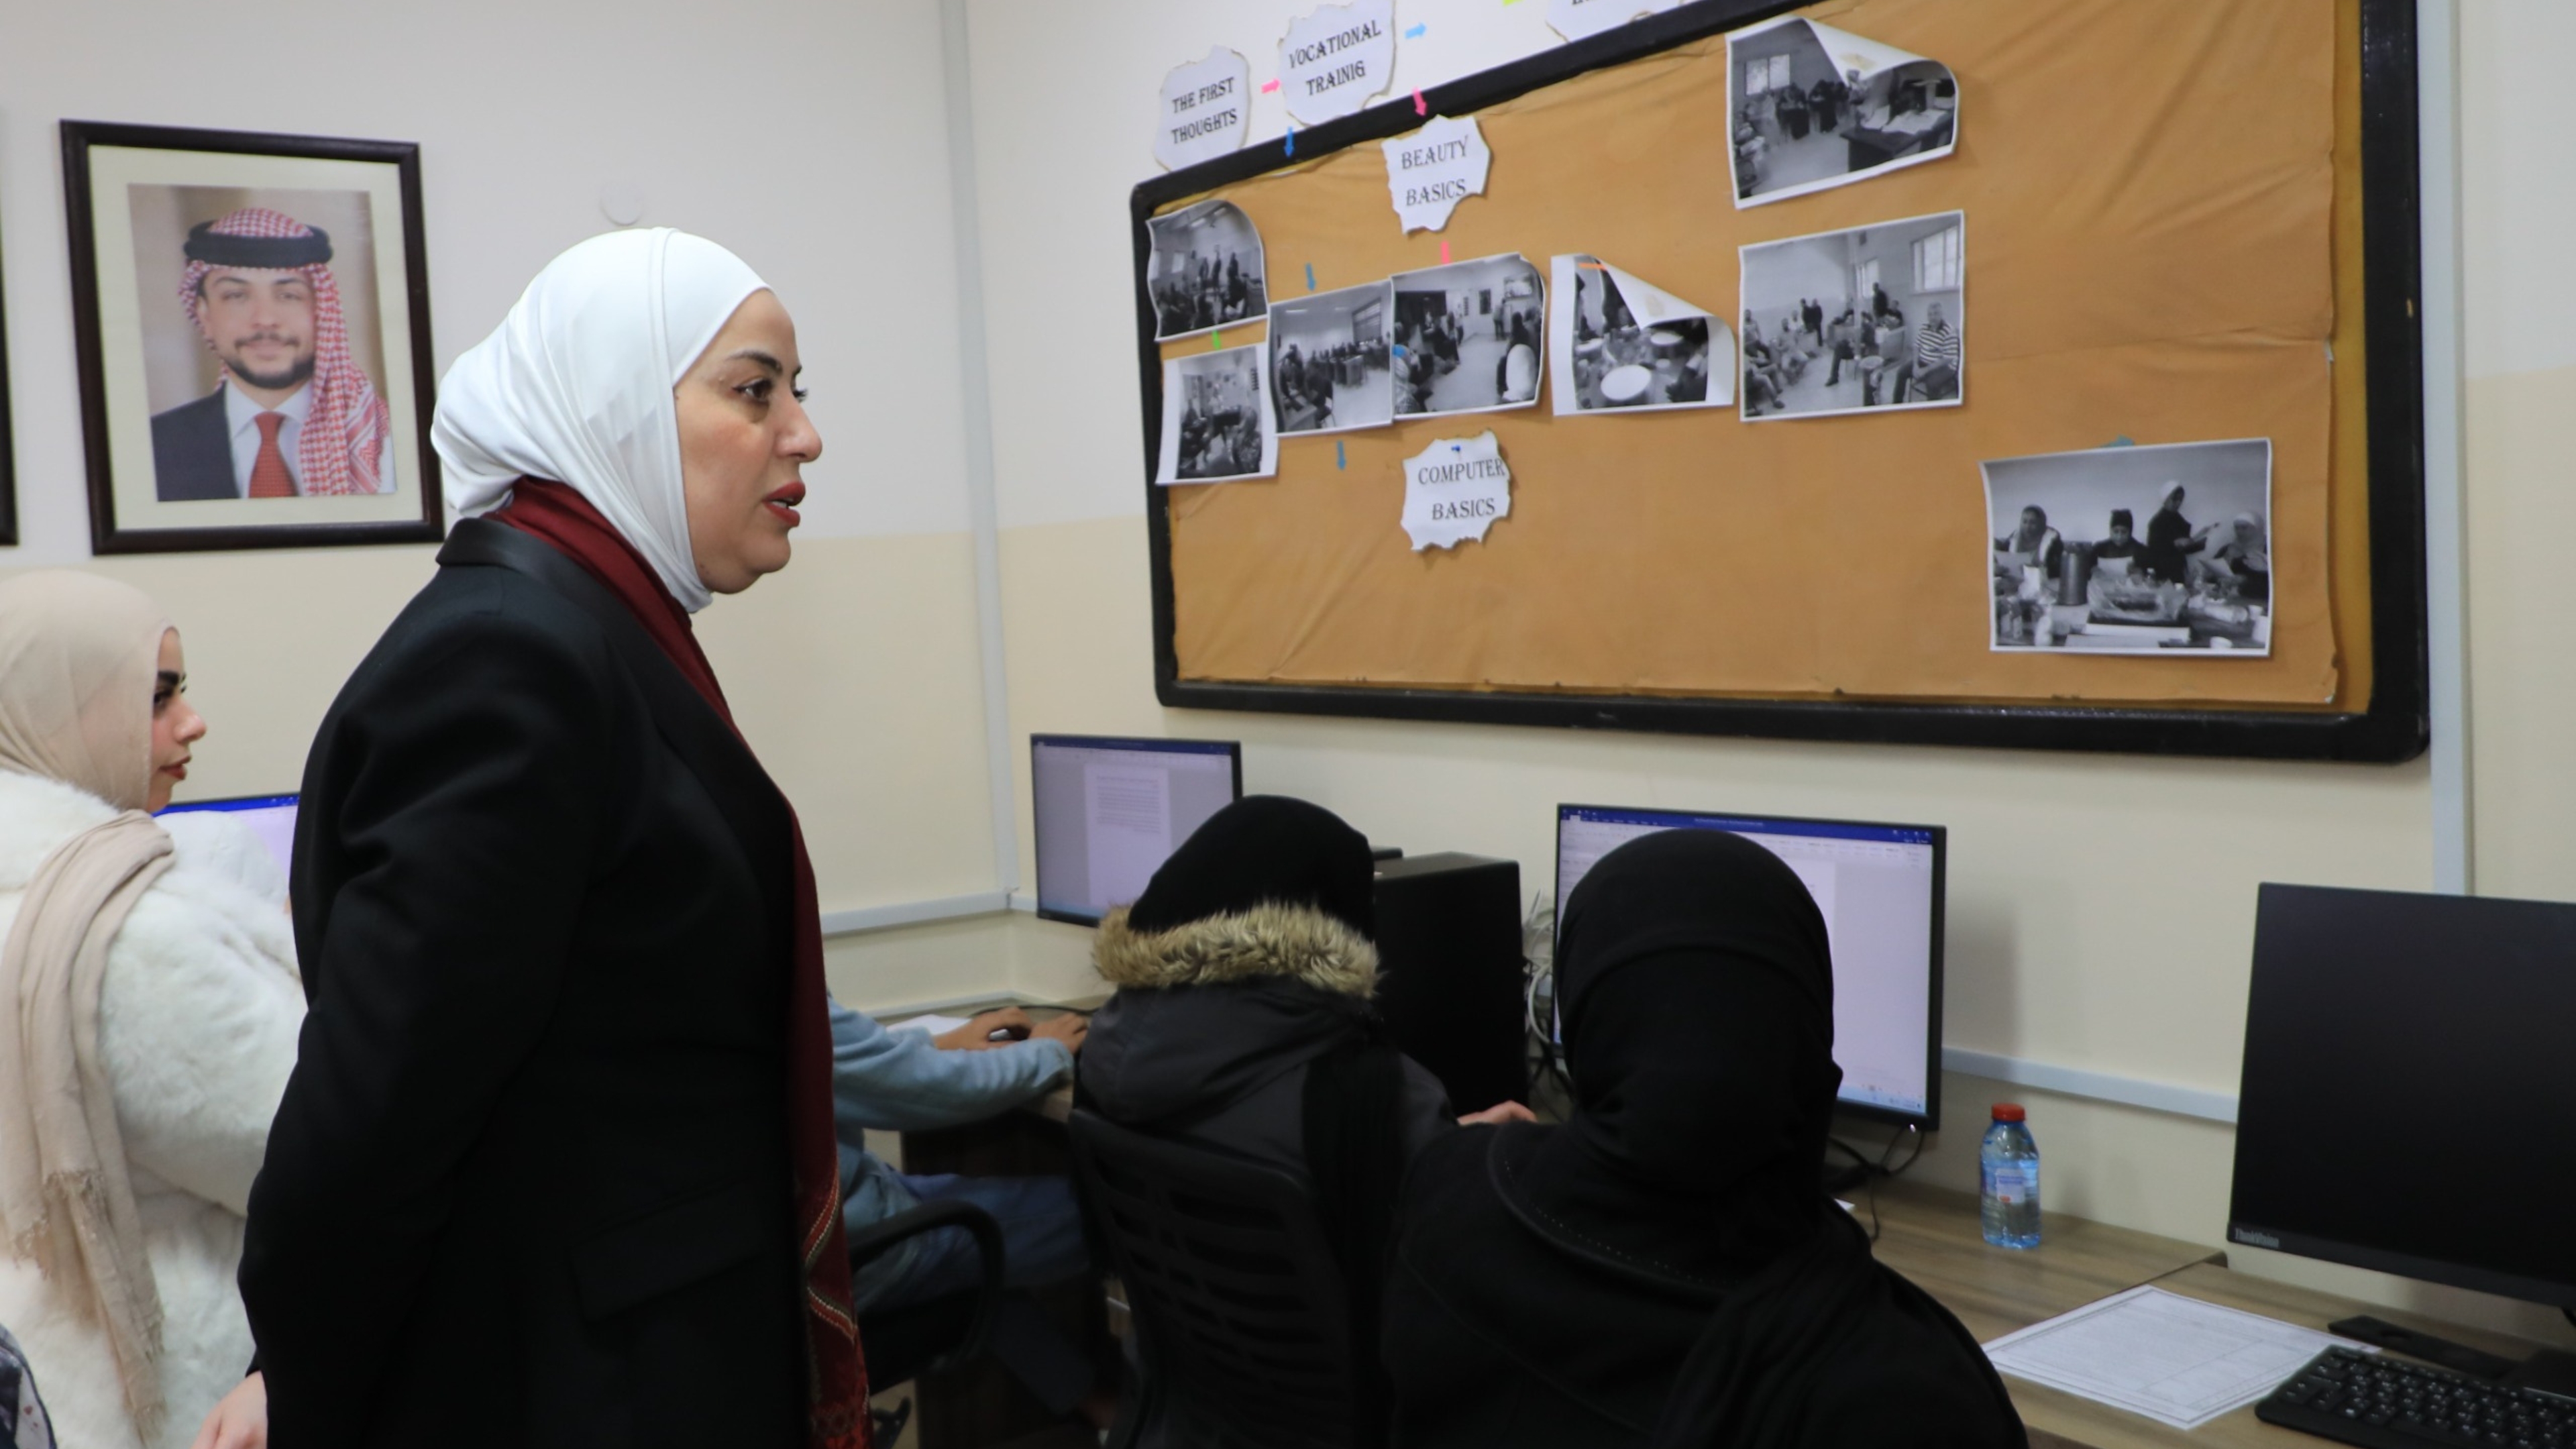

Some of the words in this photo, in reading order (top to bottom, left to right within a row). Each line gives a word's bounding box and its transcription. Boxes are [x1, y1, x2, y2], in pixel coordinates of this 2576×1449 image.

[1289, 19, 1382, 68] VOCATIONAL
[1171, 92, 1195, 113] THE
[1199, 76, 1234, 104] FIRST
[1305, 60, 1366, 95] TRAINIG
[1171, 108, 1237, 144] THOUGHTS
[1401, 134, 1468, 169] BEAUTY
[1406, 178, 1466, 206] BASICS
[1418, 458, 1506, 484] COMPUTER
[1432, 498, 1495, 521] BASICS
